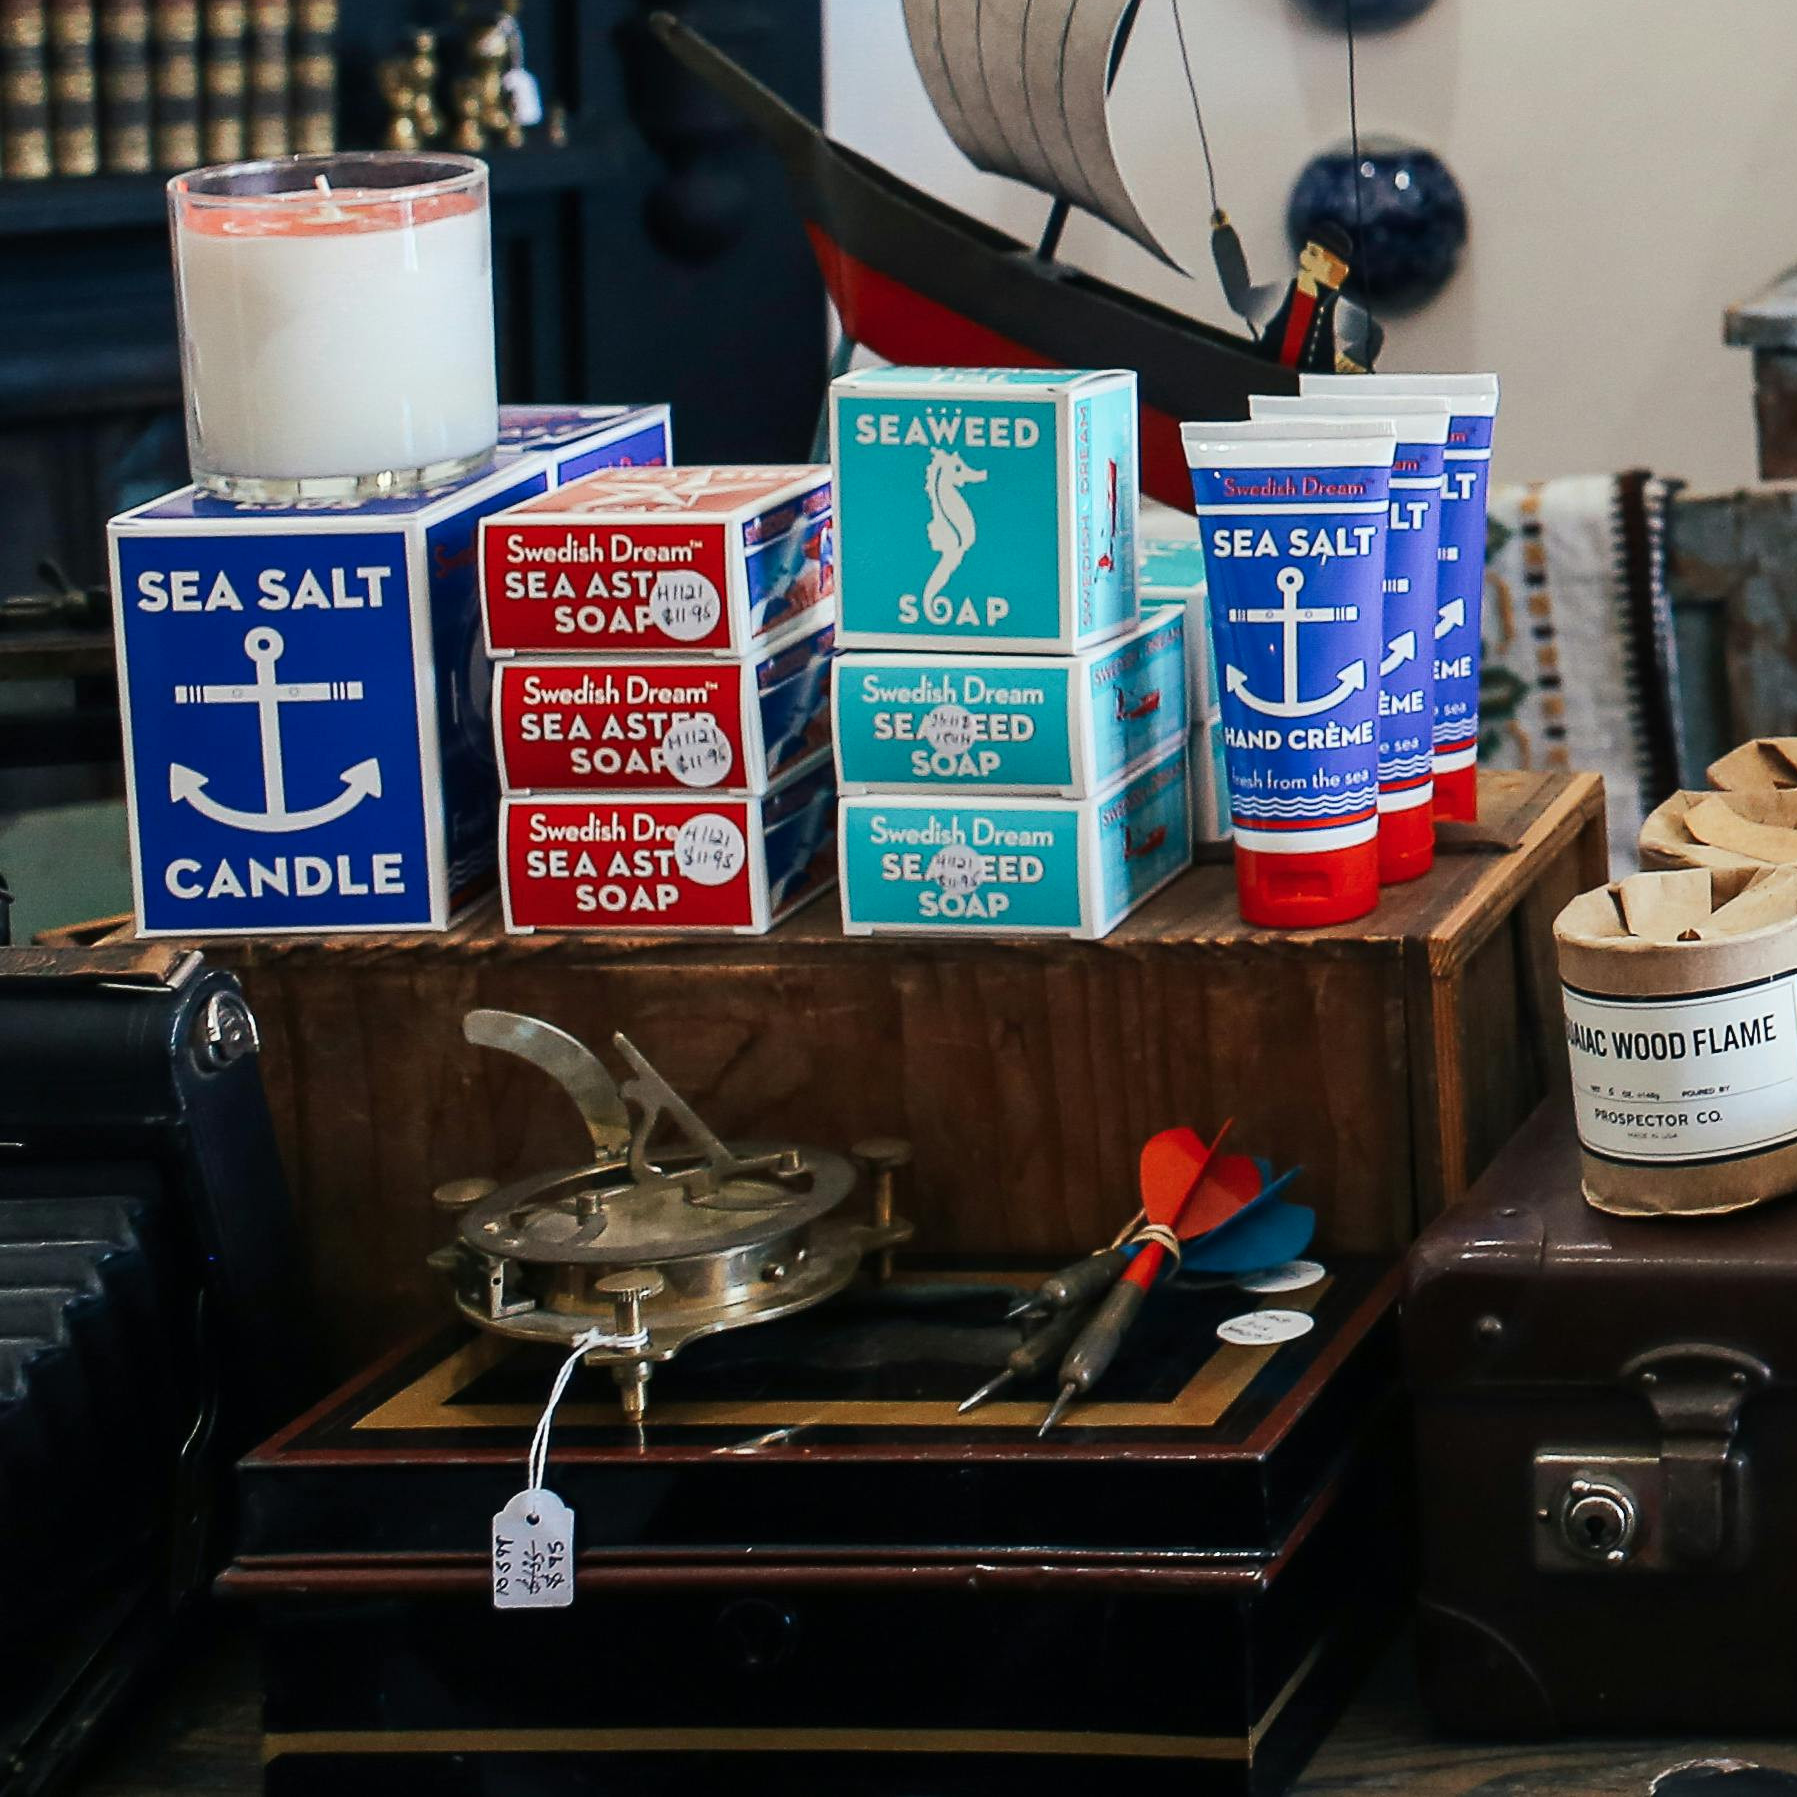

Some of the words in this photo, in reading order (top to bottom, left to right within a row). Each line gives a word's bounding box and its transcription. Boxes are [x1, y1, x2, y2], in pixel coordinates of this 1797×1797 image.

[855, 413, 1041, 448] SEAWEED
[1223, 477, 1296, 497] Swedish
[1386, 501, 1429, 530] LT
[506, 533, 603, 564] Swedish
[1213, 529, 1279, 558] SEA
[1289, 525, 1377, 558] SALT
[137, 570, 244, 613] SEA
[257, 566, 392, 611] SALT
[504, 570, 576, 599] SEA
[586, 570, 657, 599] AST
[555, 605, 656, 635] SOAP
[898, 593, 1010, 627] SOAP
[523, 675, 620, 705] Swedish
[862, 674, 956, 705] Swedish
[964, 675, 1044, 705] Dream
[521, 712, 592, 741] SEA
[873, 712, 1035, 741] SEEED
[1224, 726, 1282, 751] HAND
[1287, 720, 1373, 750] CRÈME
[570, 747, 668, 775] SOAP
[911, 750, 1001, 777] SOAP
[1267, 768, 1309, 789] from
[1312, 767, 1340, 789] the
[1344, 769, 1369, 785] sea
[529, 812, 627, 843] Swedish
[870, 814, 966, 845] Swedish
[973, 817, 1054, 847] Dream
[165, 853, 405, 900] CANDLE
[526, 850, 598, 879] SEA
[607, 850, 680, 878] AST
[881, 852, 1044, 884] SEEED
[575, 884, 680, 911] SOAP
[918, 891, 1010, 918] SOAP
[1568, 1019, 1608, 1057] AIAC
[1612, 1031, 1686, 1061] WOOD
[1693, 1014, 1777, 1056] FLAME
[1594, 1108, 1688, 1127] PROSPECTOR
[1697, 1110, 1723, 1124] CO.
